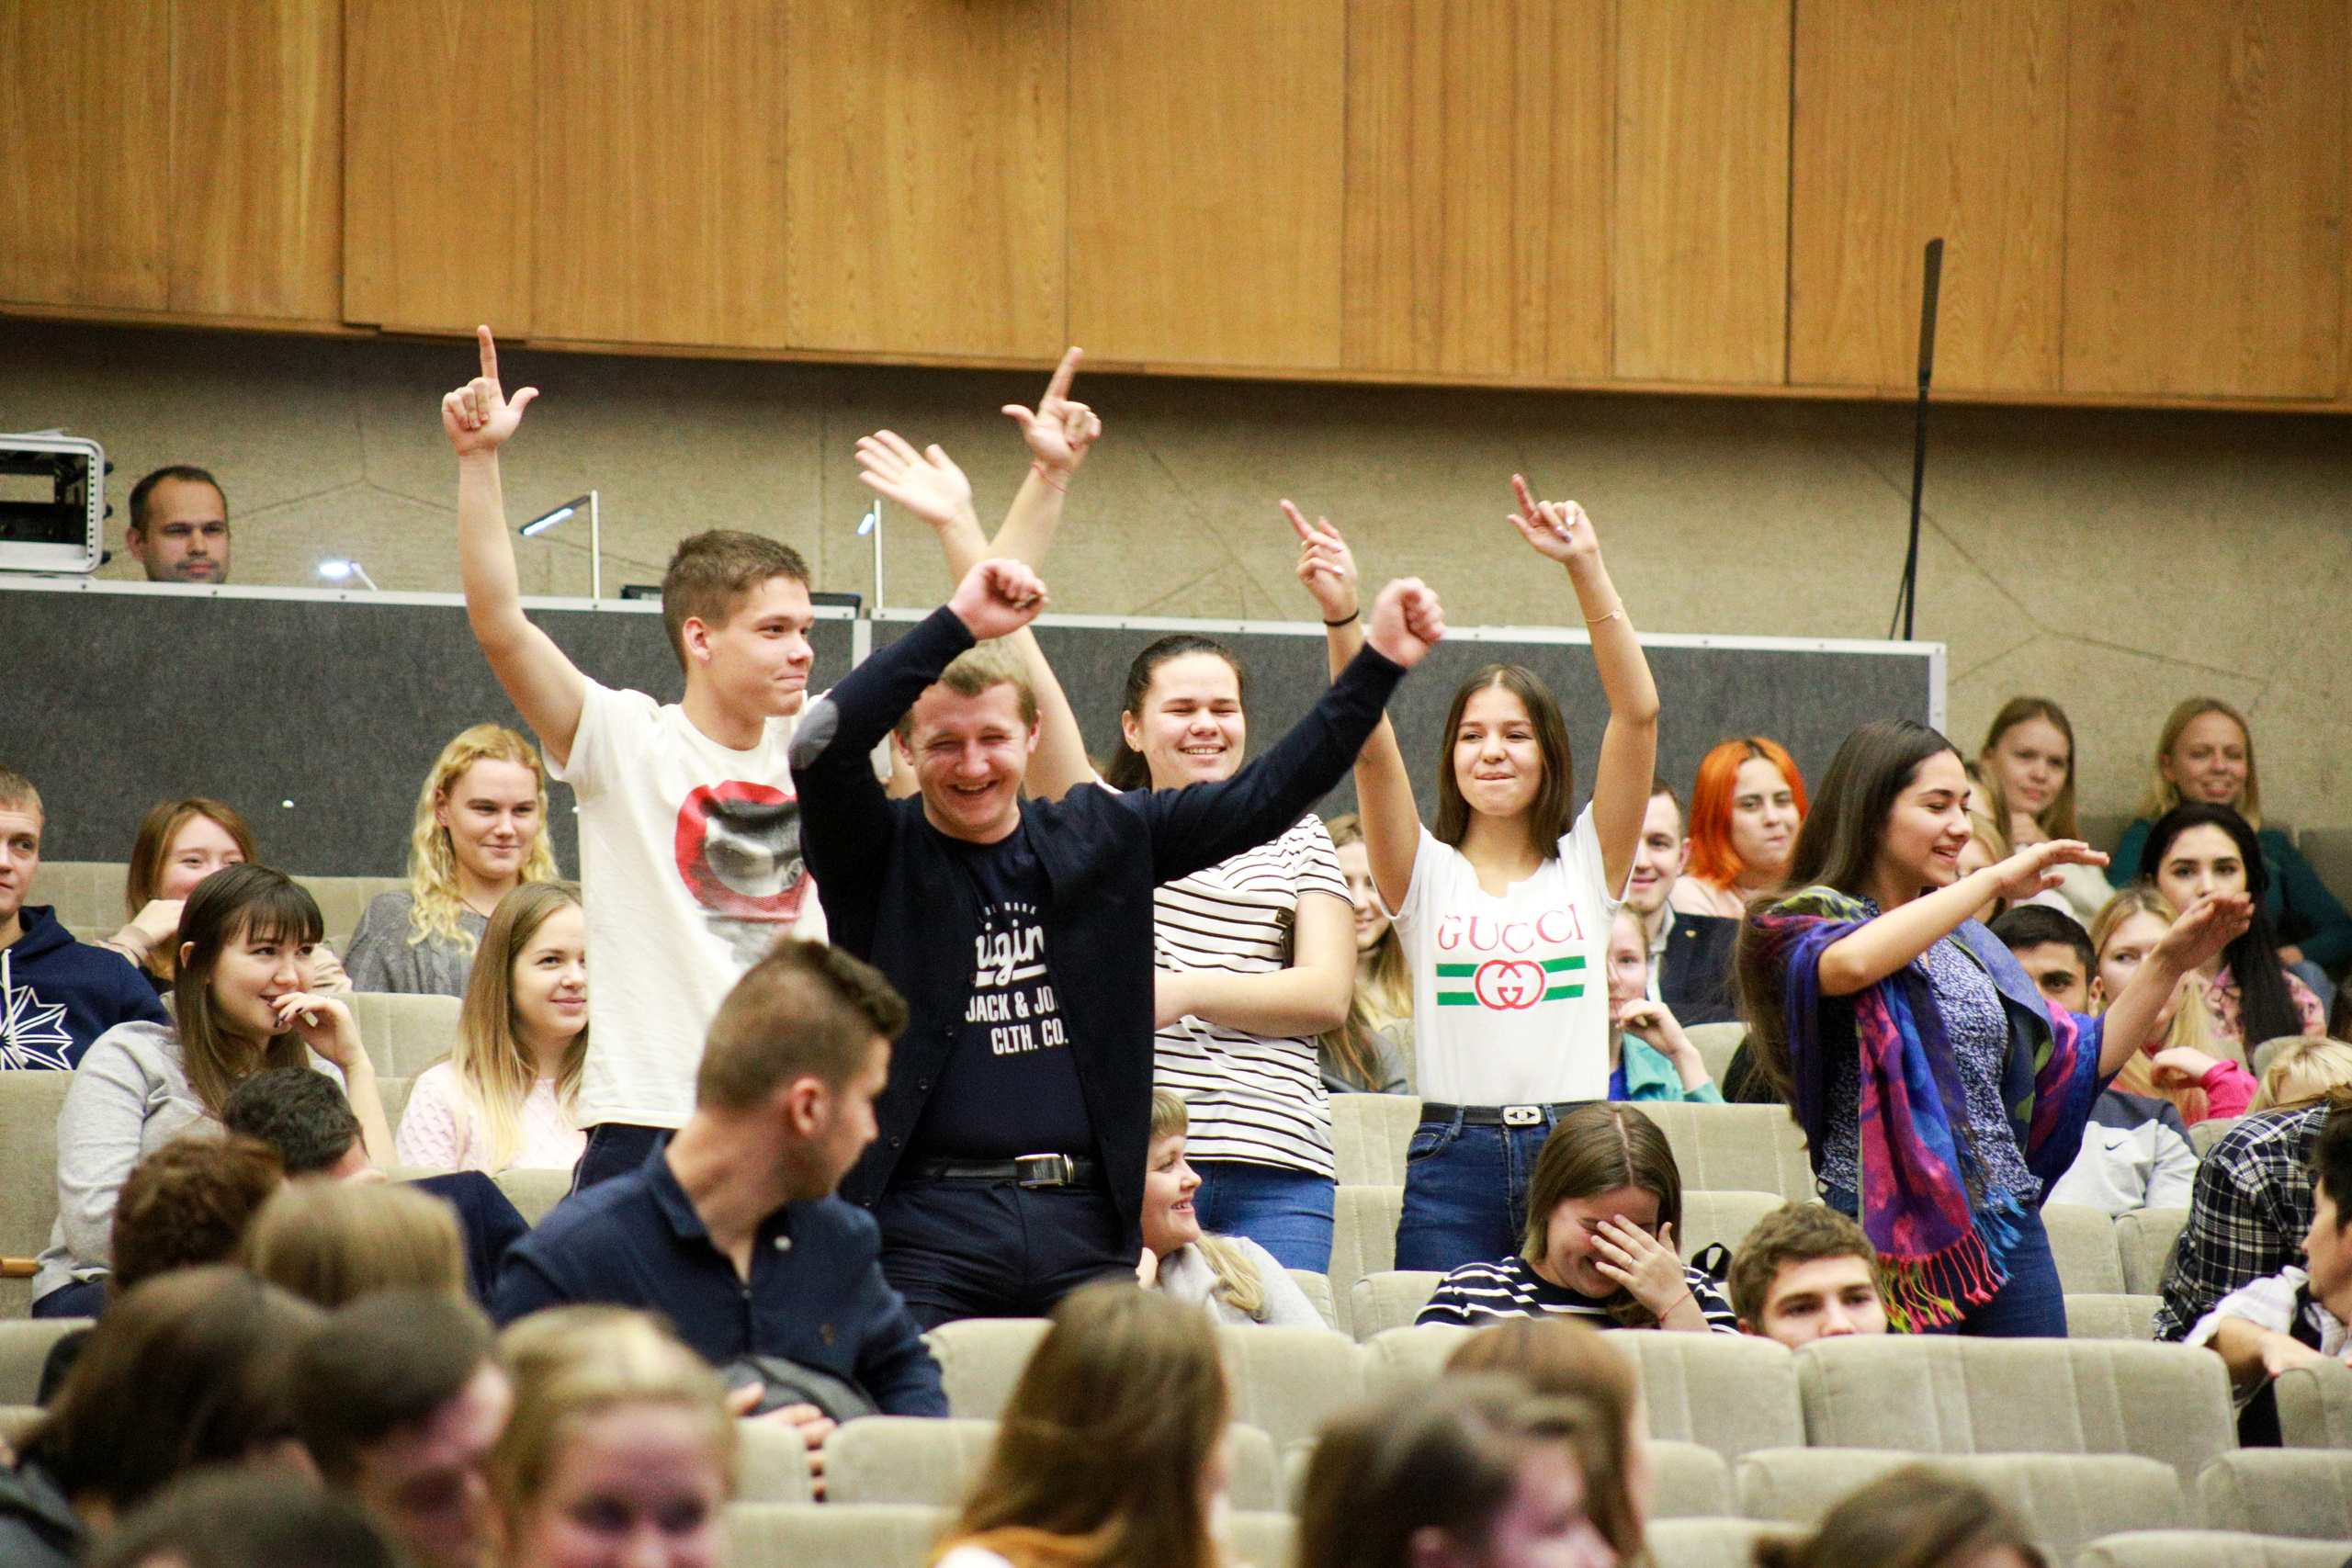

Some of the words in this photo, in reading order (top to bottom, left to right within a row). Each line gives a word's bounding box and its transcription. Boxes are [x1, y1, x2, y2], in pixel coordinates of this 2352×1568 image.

[1438, 903, 1585, 953] GUCCI
[965, 993, 1012, 1022] JACK
[1013, 990, 1030, 1019] &
[1034, 985, 1059, 1015] JO
[990, 1023, 1039, 1055] CLTH.
[1041, 1017, 1069, 1047] CO.
